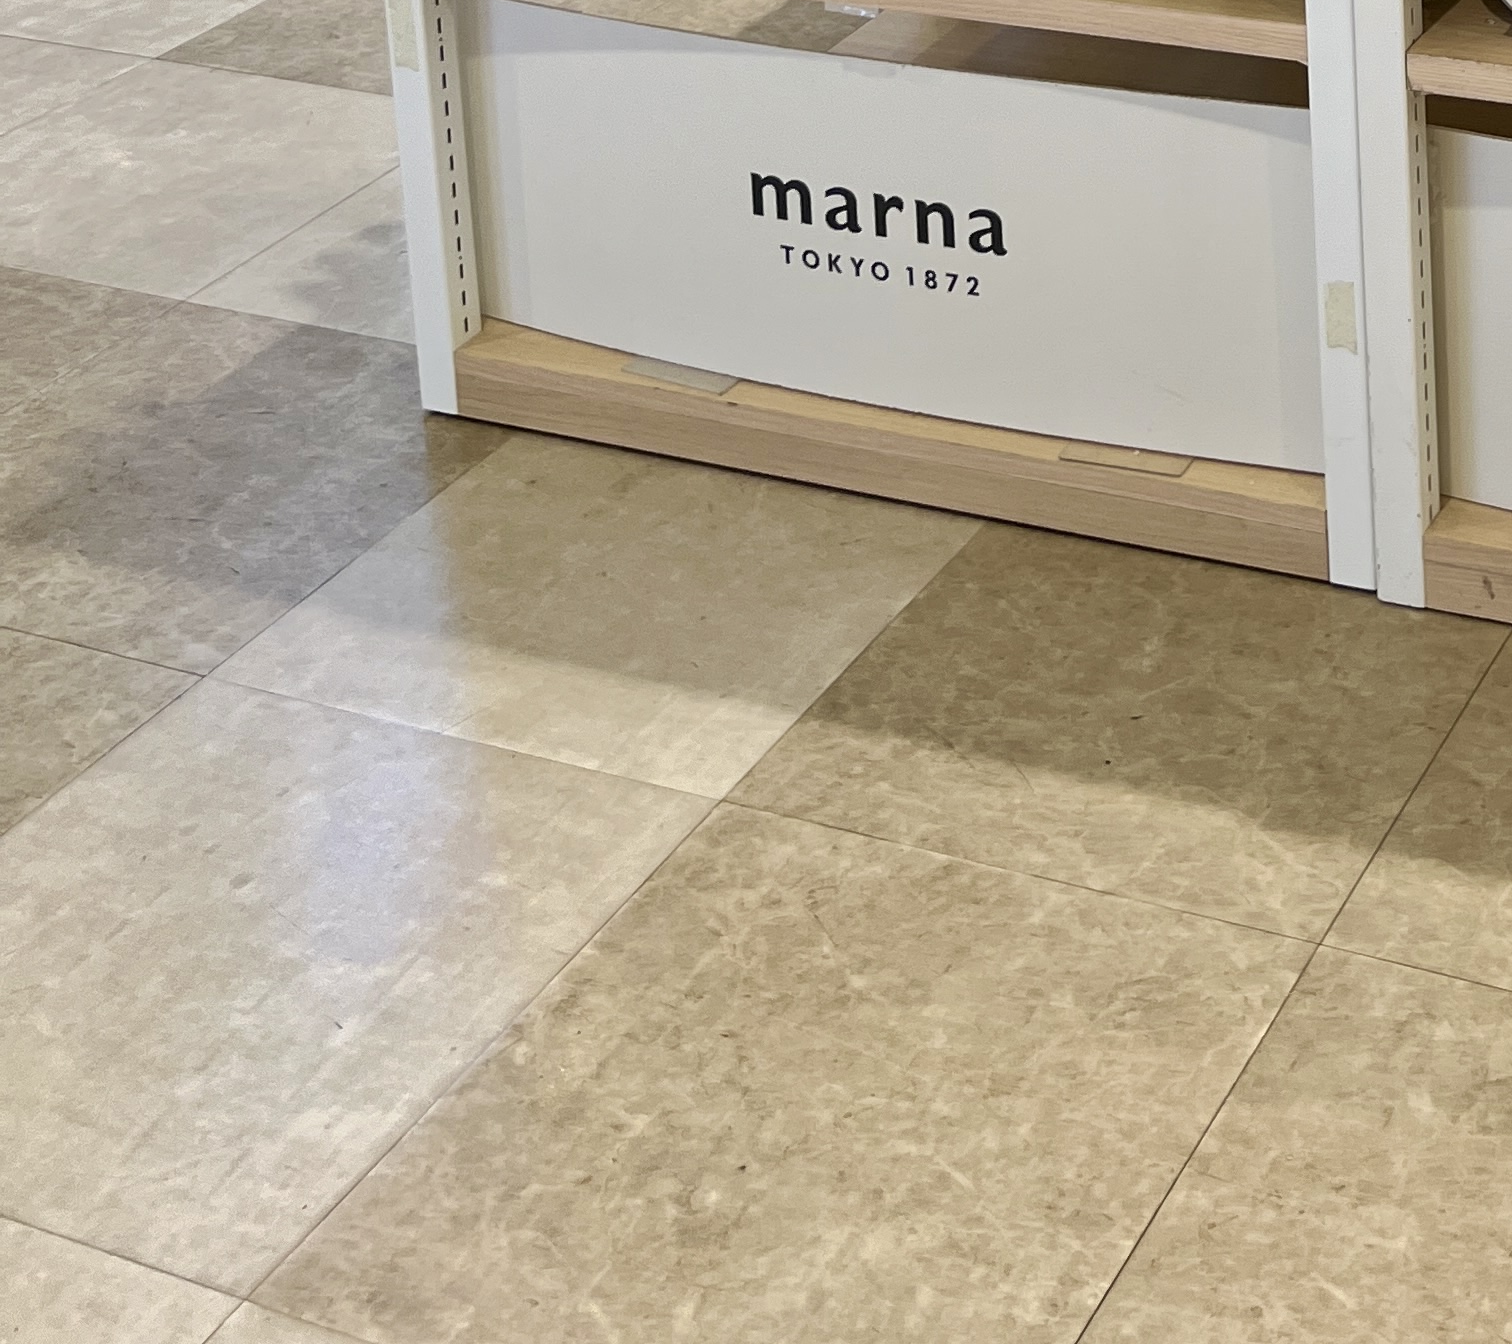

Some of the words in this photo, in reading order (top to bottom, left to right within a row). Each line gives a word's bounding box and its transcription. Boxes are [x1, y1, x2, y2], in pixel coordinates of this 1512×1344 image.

[750, 172, 1008, 257] marna
[780, 244, 891, 281] TOKYO
[905, 265, 980, 297] 1872
